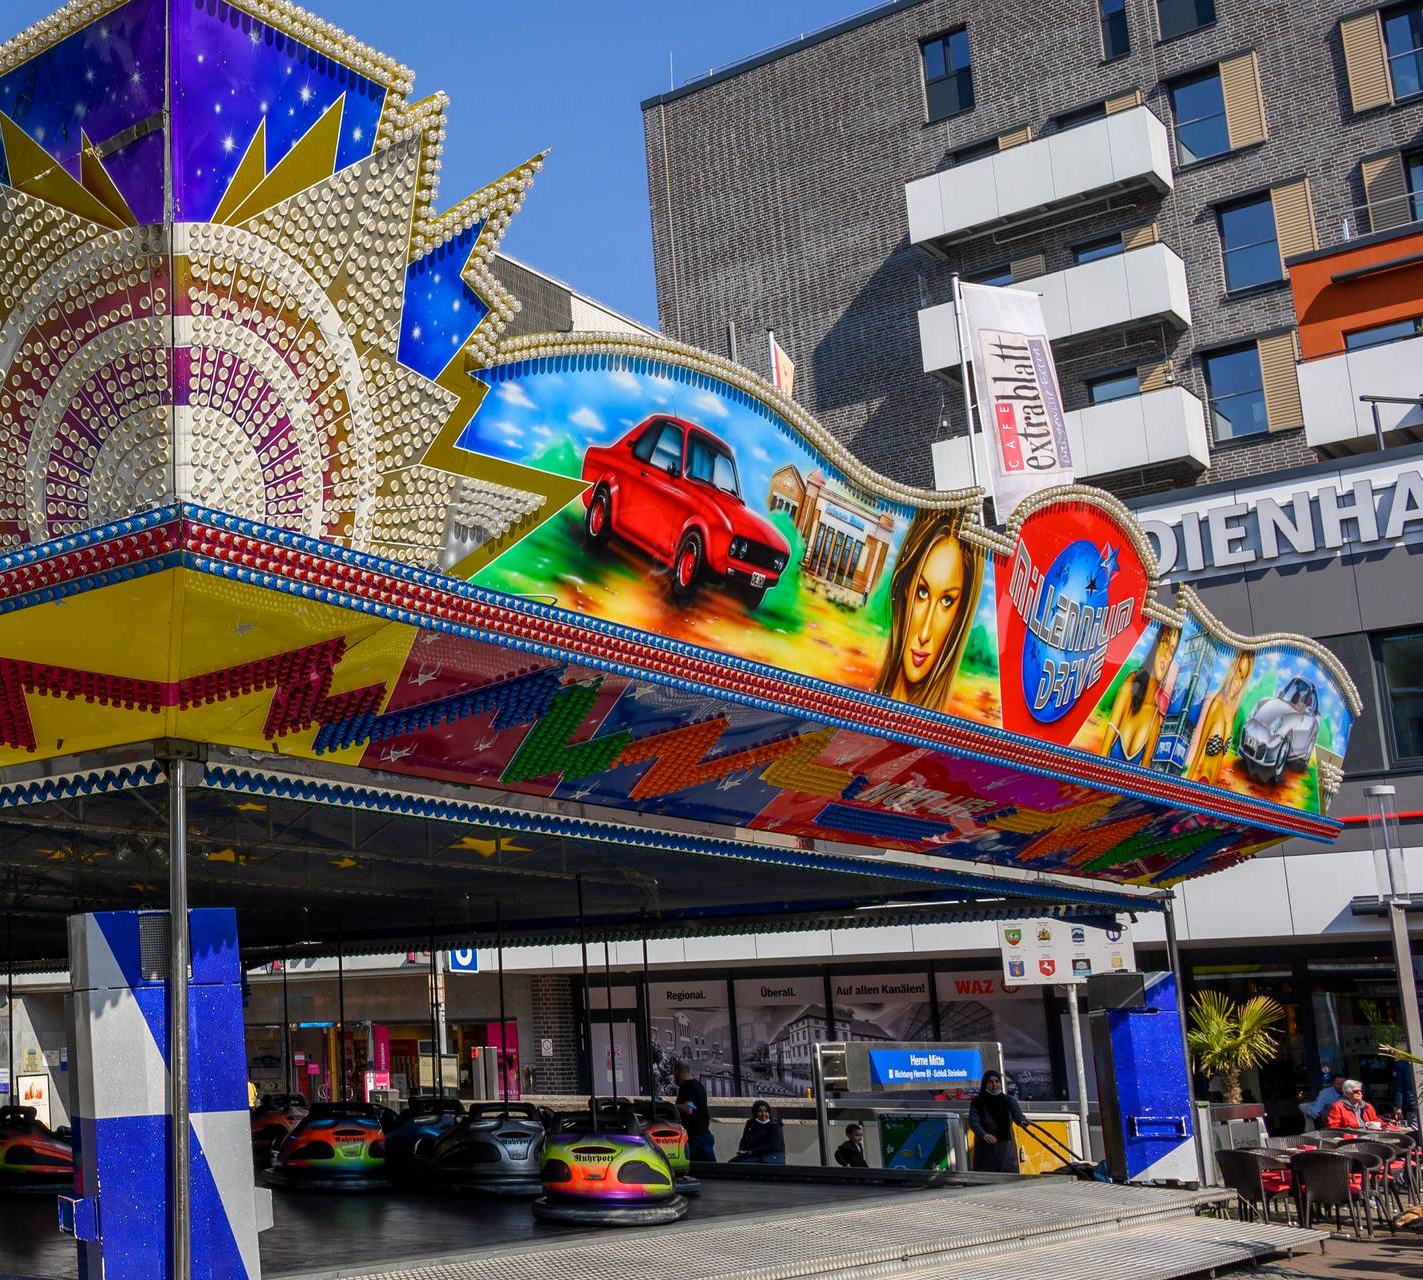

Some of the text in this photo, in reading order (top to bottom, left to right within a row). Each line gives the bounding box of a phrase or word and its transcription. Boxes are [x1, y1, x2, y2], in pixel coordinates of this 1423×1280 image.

[988, 334, 1057, 471] extrablatt
[761, 986, 797, 997] Überall.
[836, 983, 925, 995] Auf allen Kanälen!
[954, 979, 993, 995] WAZ
[666, 990, 706, 1001] Regional.
[910, 1054, 945, 1066] Herne Mitte
[894, 1069, 913, 1079] Richtung
[913, 1069, 926, 1078] Herne
[574, 1154, 614, 1164] Ruhrpott
